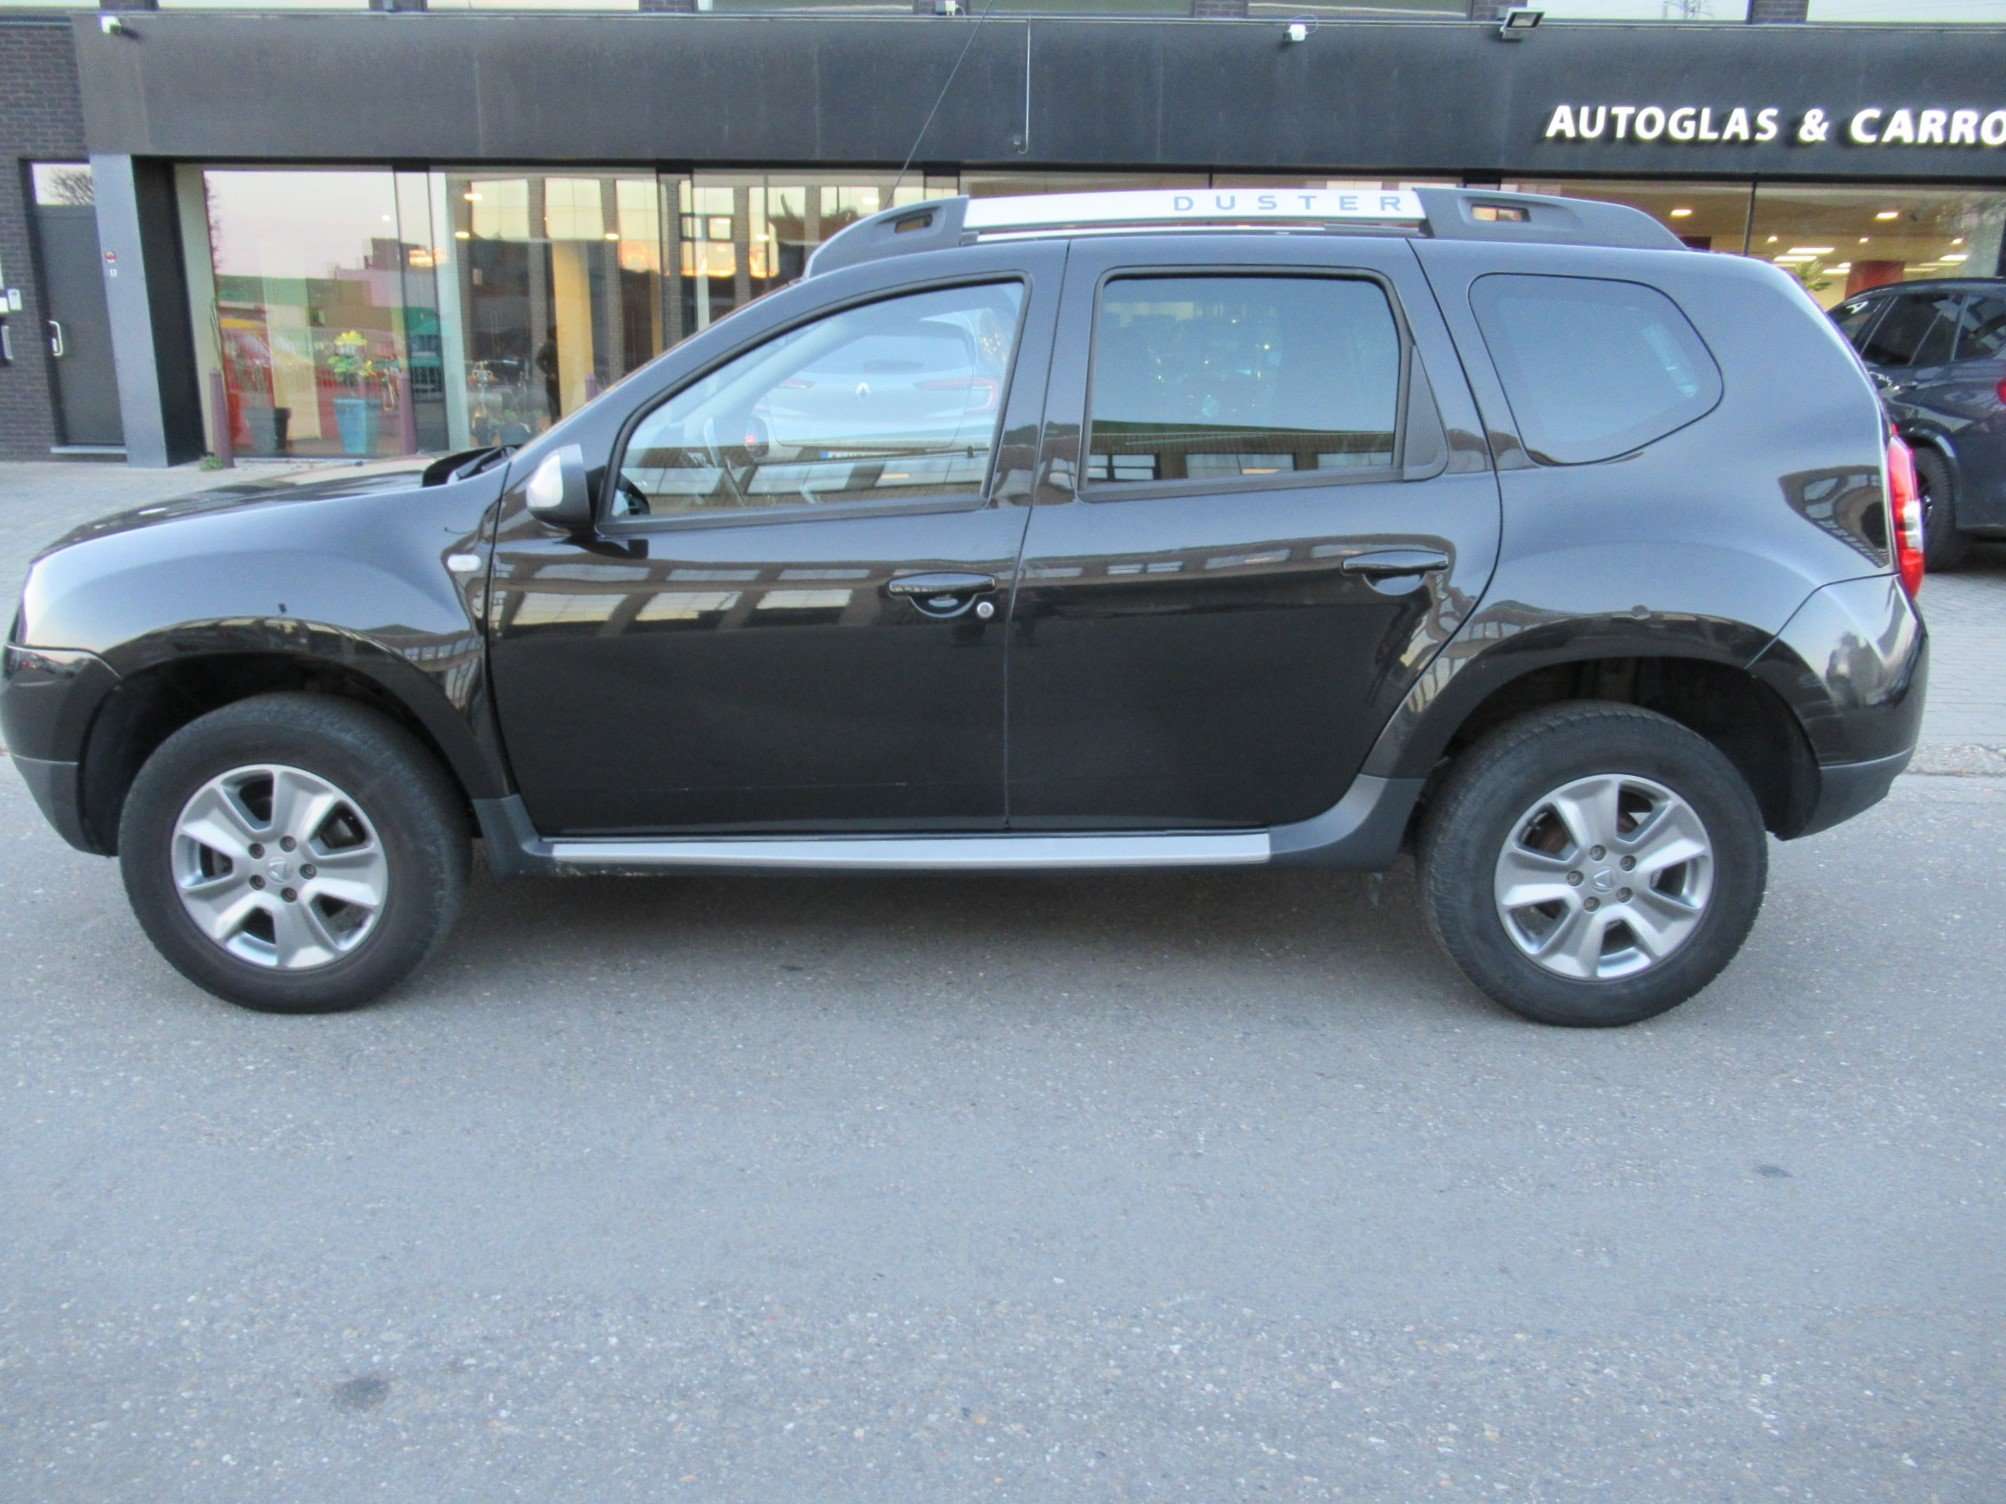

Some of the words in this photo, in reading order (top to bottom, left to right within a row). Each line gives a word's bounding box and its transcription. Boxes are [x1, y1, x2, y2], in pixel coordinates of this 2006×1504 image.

[1545, 105, 1779, 141] AUTOGLAS
[1799, 108, 1829, 142] &
[1850, 108, 2006, 145] CARRO
[1173, 195, 1401, 212] DUSTER
